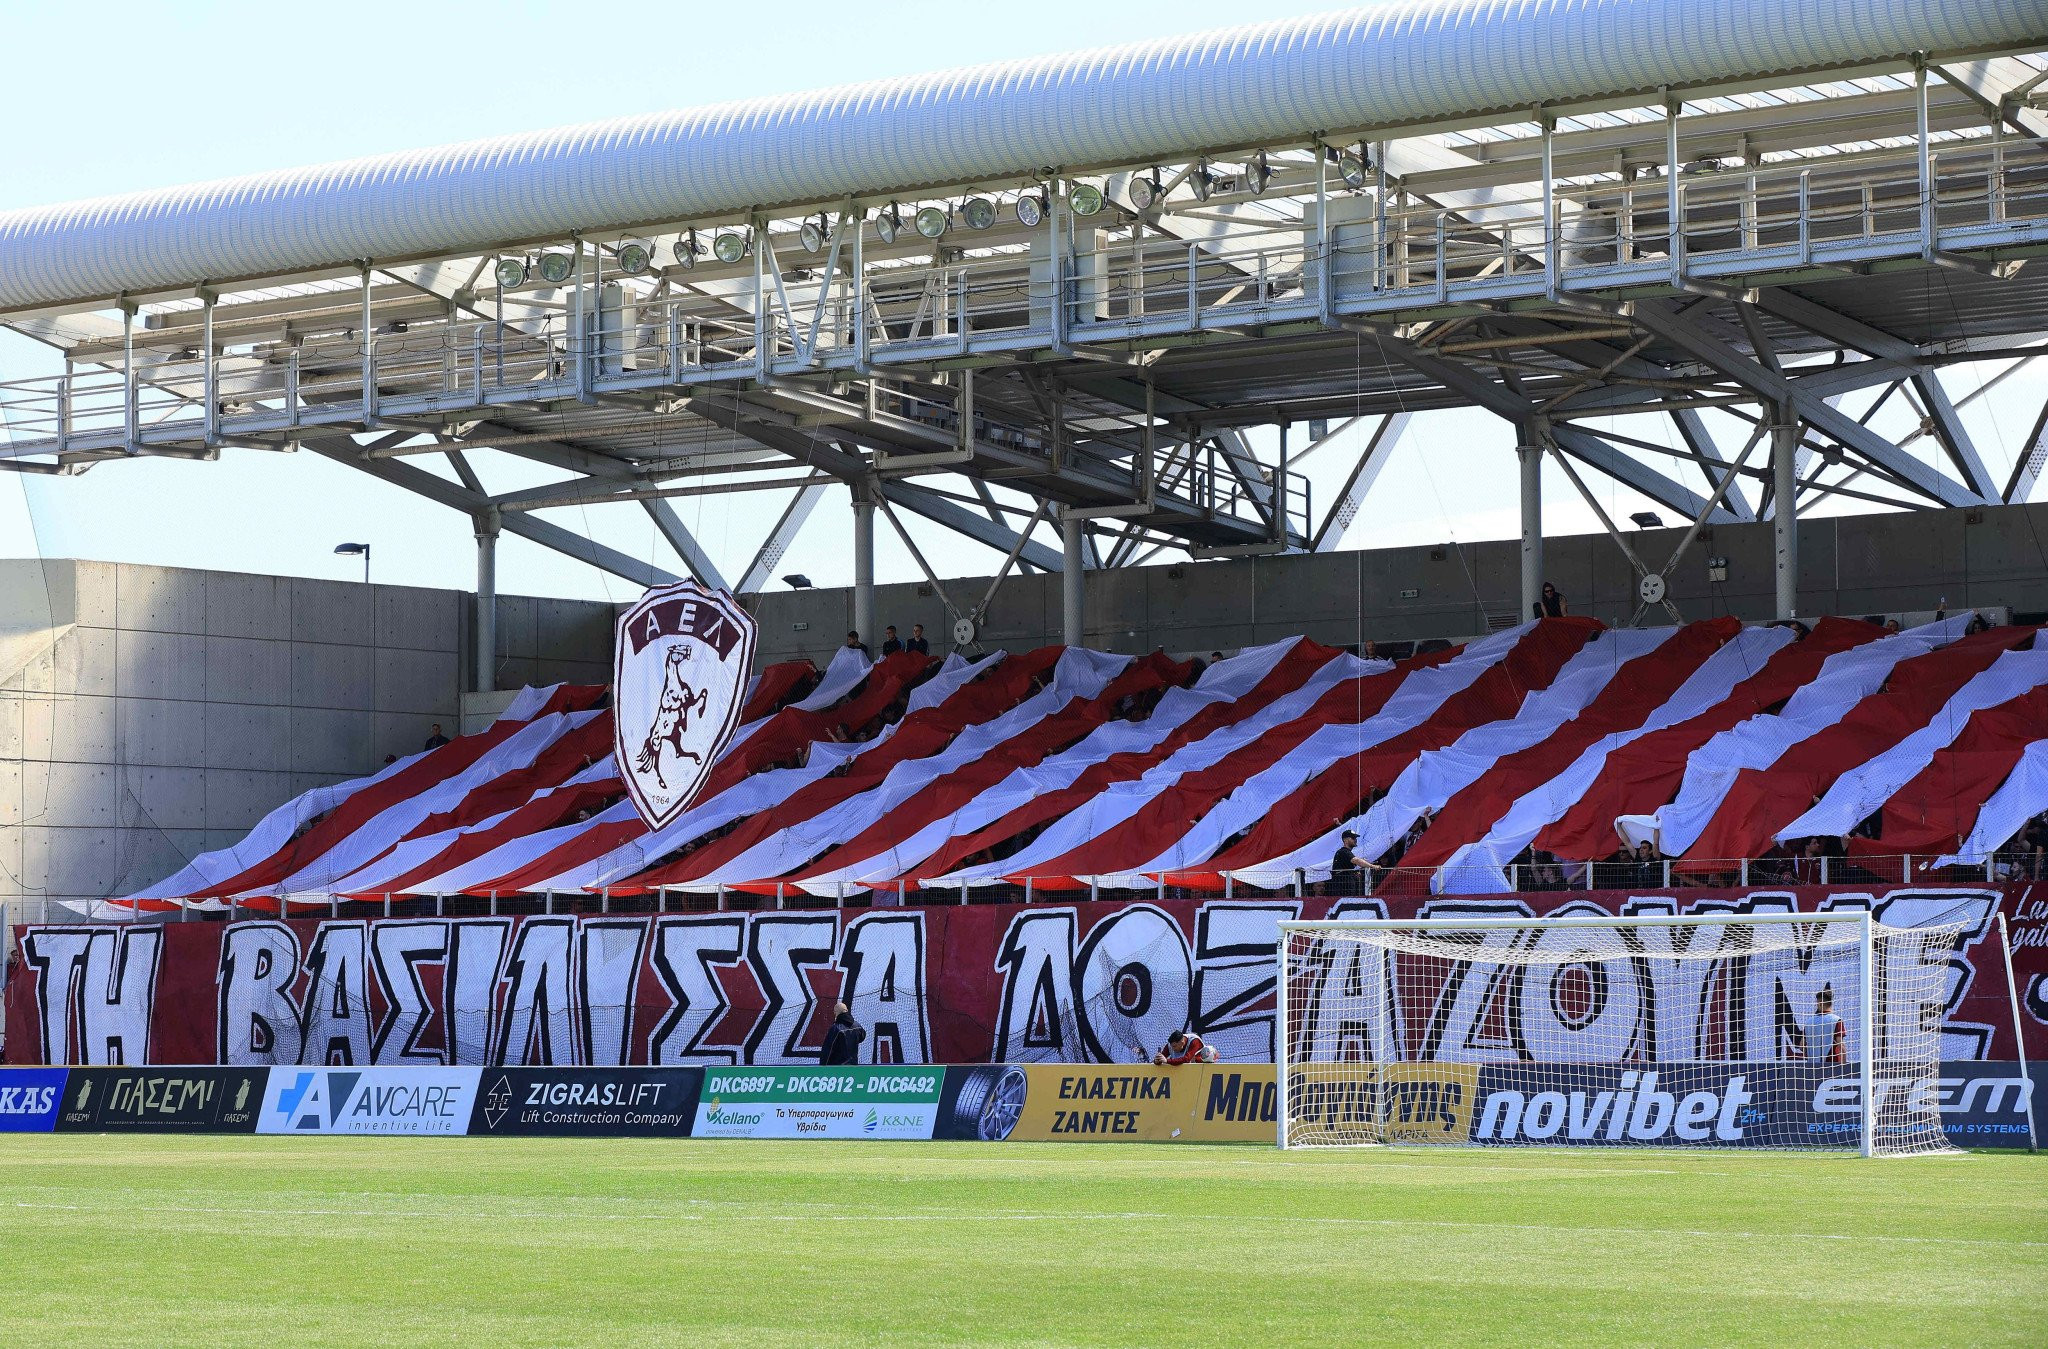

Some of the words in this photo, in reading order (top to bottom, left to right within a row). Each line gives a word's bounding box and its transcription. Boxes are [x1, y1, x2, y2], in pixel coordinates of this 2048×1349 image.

[651, 795, 670, 805] 1964
[20, 923, 164, 1065] ΤΗ
[216, 909, 935, 1065] ΒΑΣΙΛΙΣΣΑ
[709, 1076, 775, 1093] DKC6897
[787, 1076, 854, 1093] DKC6812
[867, 1076, 936, 1093] DKC6492
[1059, 1077, 1171, 1099] ΕΛΑΣΤΙΚΑ
[352, 1086, 461, 1117] AVCARE
[525, 1083, 666, 1105] ZIGRASLIFT
[776, 1108, 785, 1118] Τα
[1477, 1070, 1752, 1140] novibet
[521, 1110, 539, 1123] Lift
[543, 1111, 620, 1124] Construction
[624, 1111, 683, 1126] Company
[882, 1115, 924, 1126] K&NE
[1051, 1111, 1140, 1133] ΖΑΝΤΕΣ
[1741, 1109, 1766, 1123] 21+
[349, 1120, 417, 1131] inventive
[425, 1119, 451, 1131] life
[796, 1122, 827, 1133] Υβρίδια
[1967, 1123, 2030, 1133] SYSTEMS
